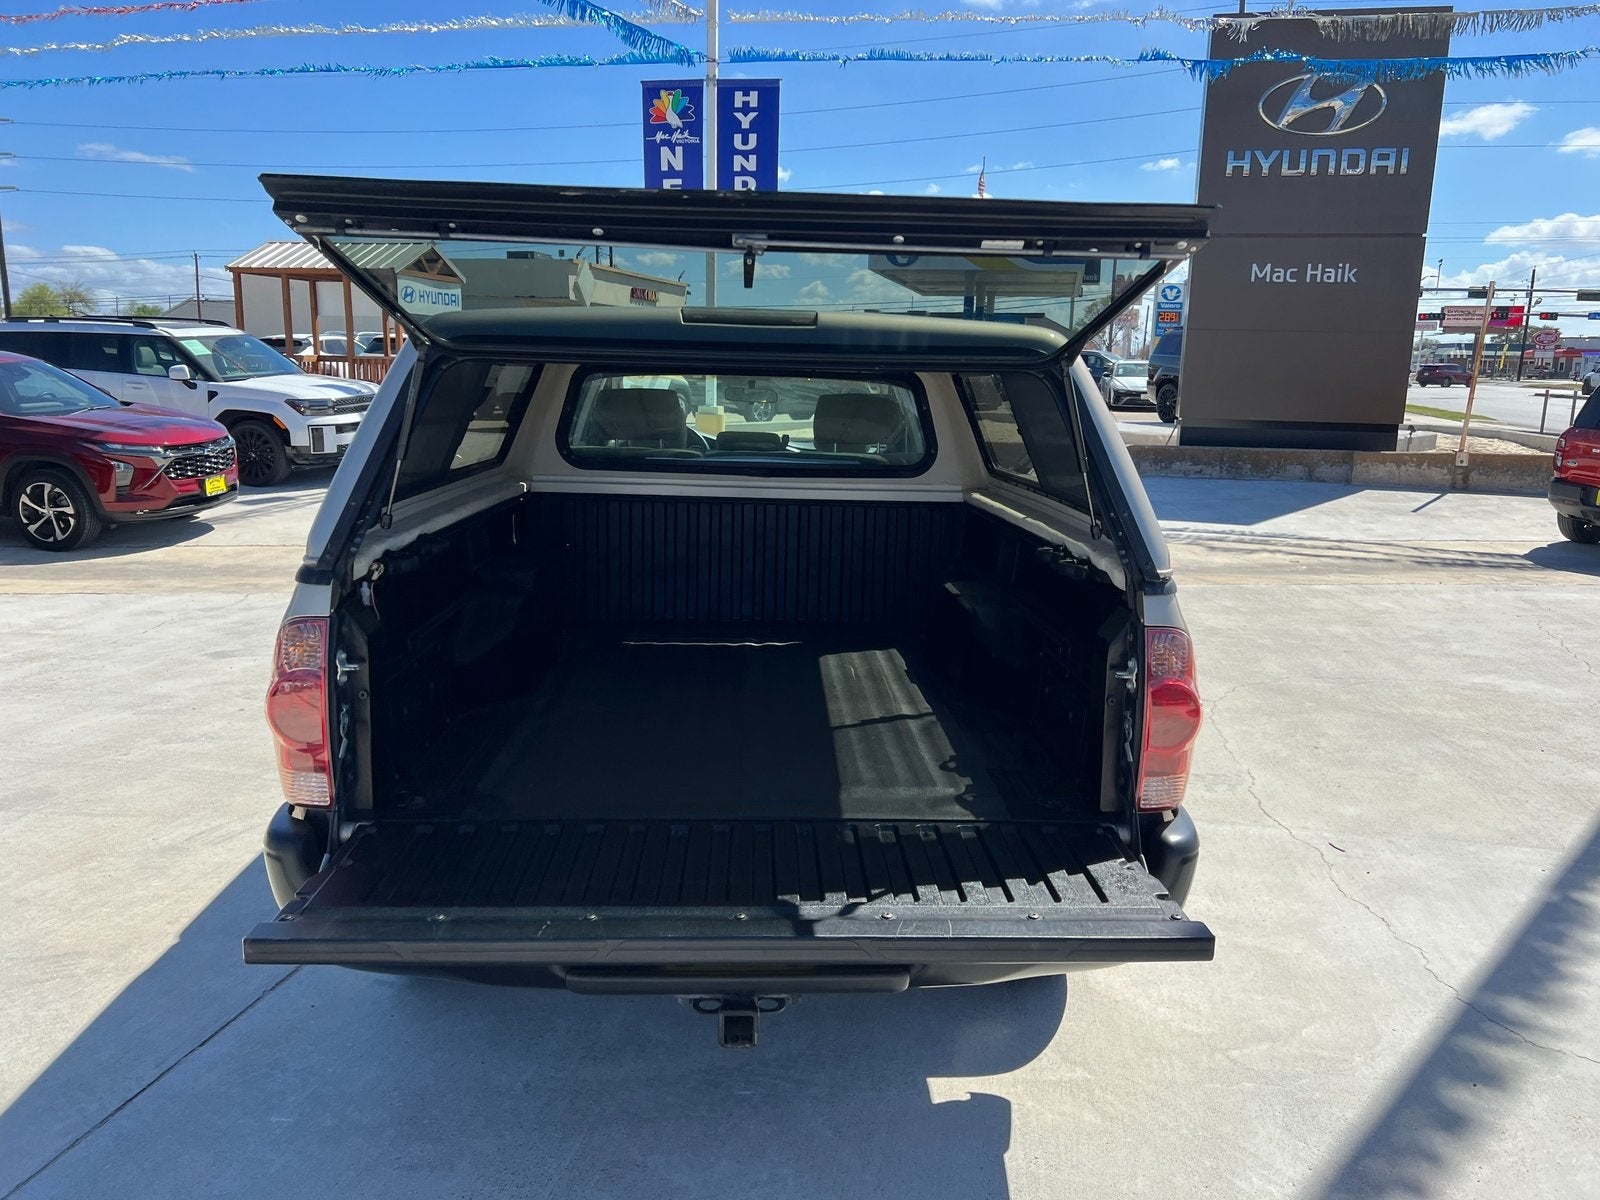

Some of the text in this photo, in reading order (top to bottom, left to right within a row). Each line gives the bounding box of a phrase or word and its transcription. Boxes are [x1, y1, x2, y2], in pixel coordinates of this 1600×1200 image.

[646, 128, 700, 144] Mac Haik
[1225, 147, 1410, 178] HYUNDAI
[1250, 263, 1358, 284] Mac Haik
[418, 289, 460, 308] HYUNDAI
